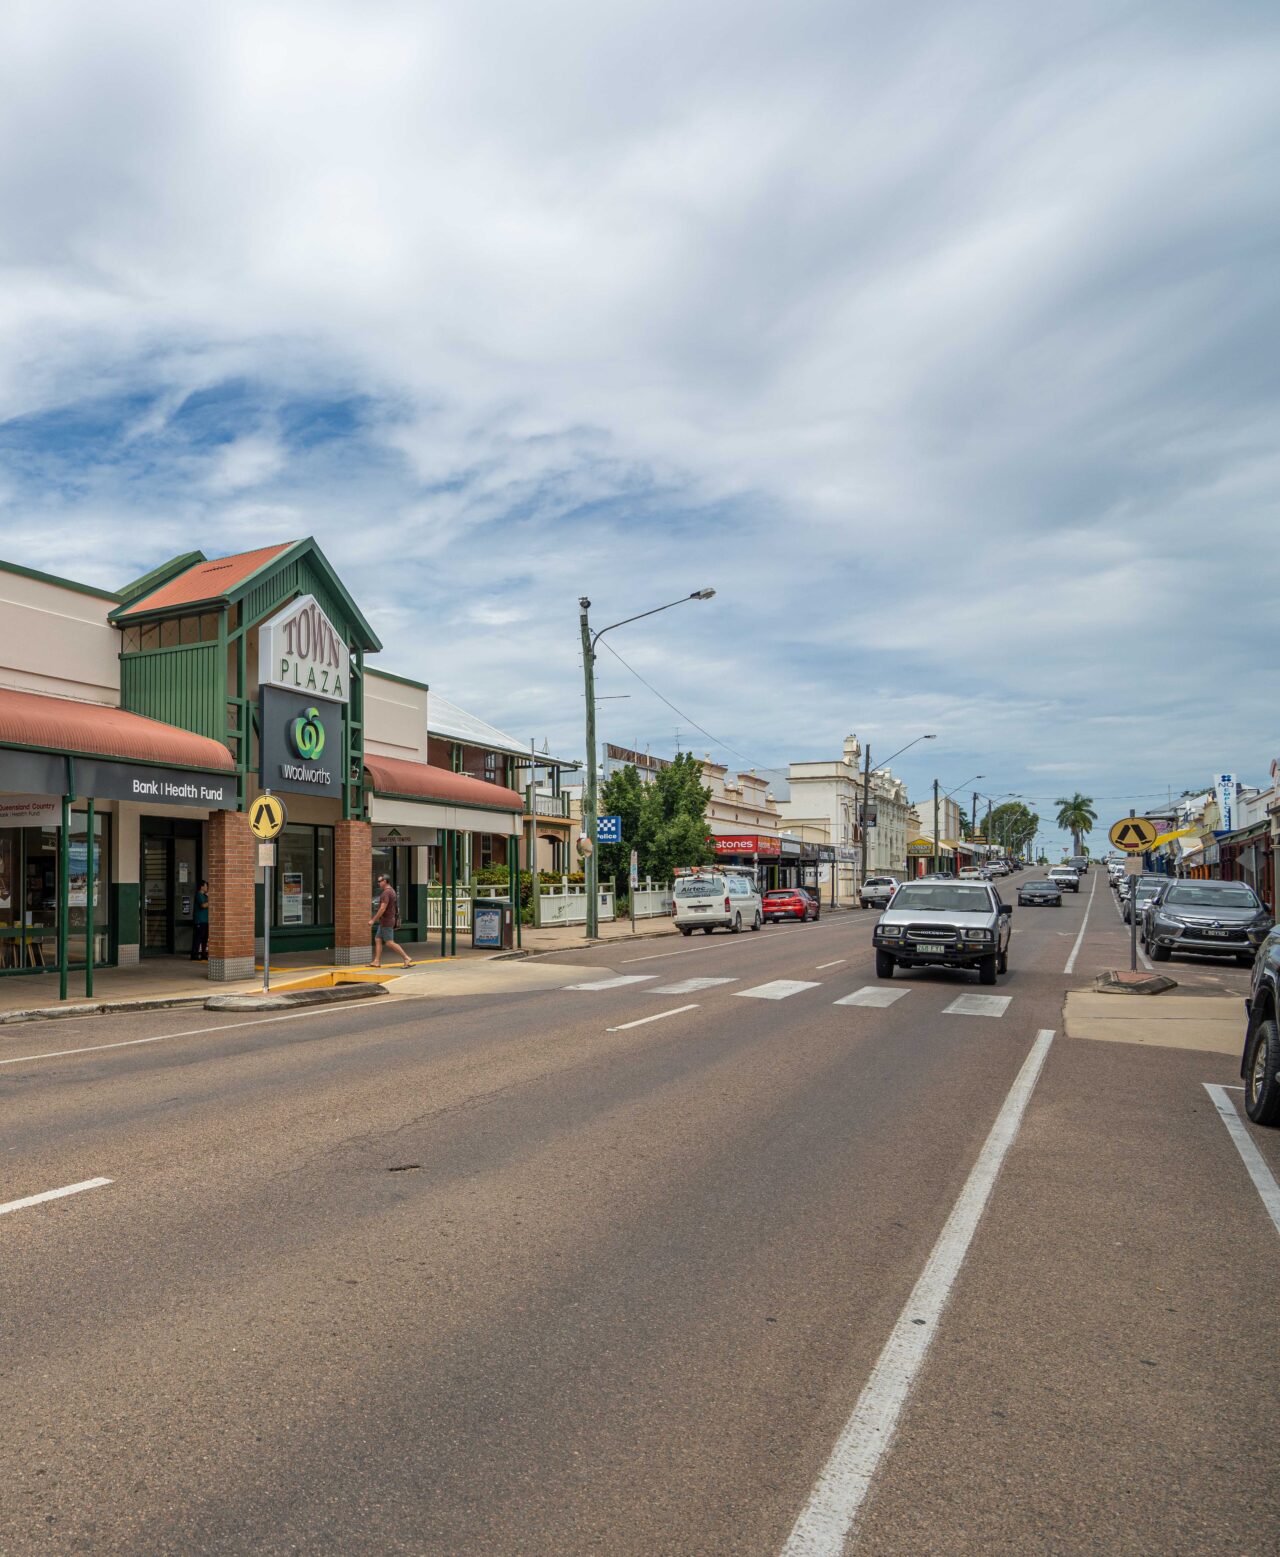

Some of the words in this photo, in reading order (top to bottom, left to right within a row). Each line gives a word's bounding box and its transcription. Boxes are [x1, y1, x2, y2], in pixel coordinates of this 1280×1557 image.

[283, 603, 340, 669] TOWN
[281, 658, 343, 696] PLAZA
[132, 779, 159, 795] Bank
[165, 782, 198, 798] Health
[200, 786, 223, 800] Fund
[32, 802, 55, 811] Country
